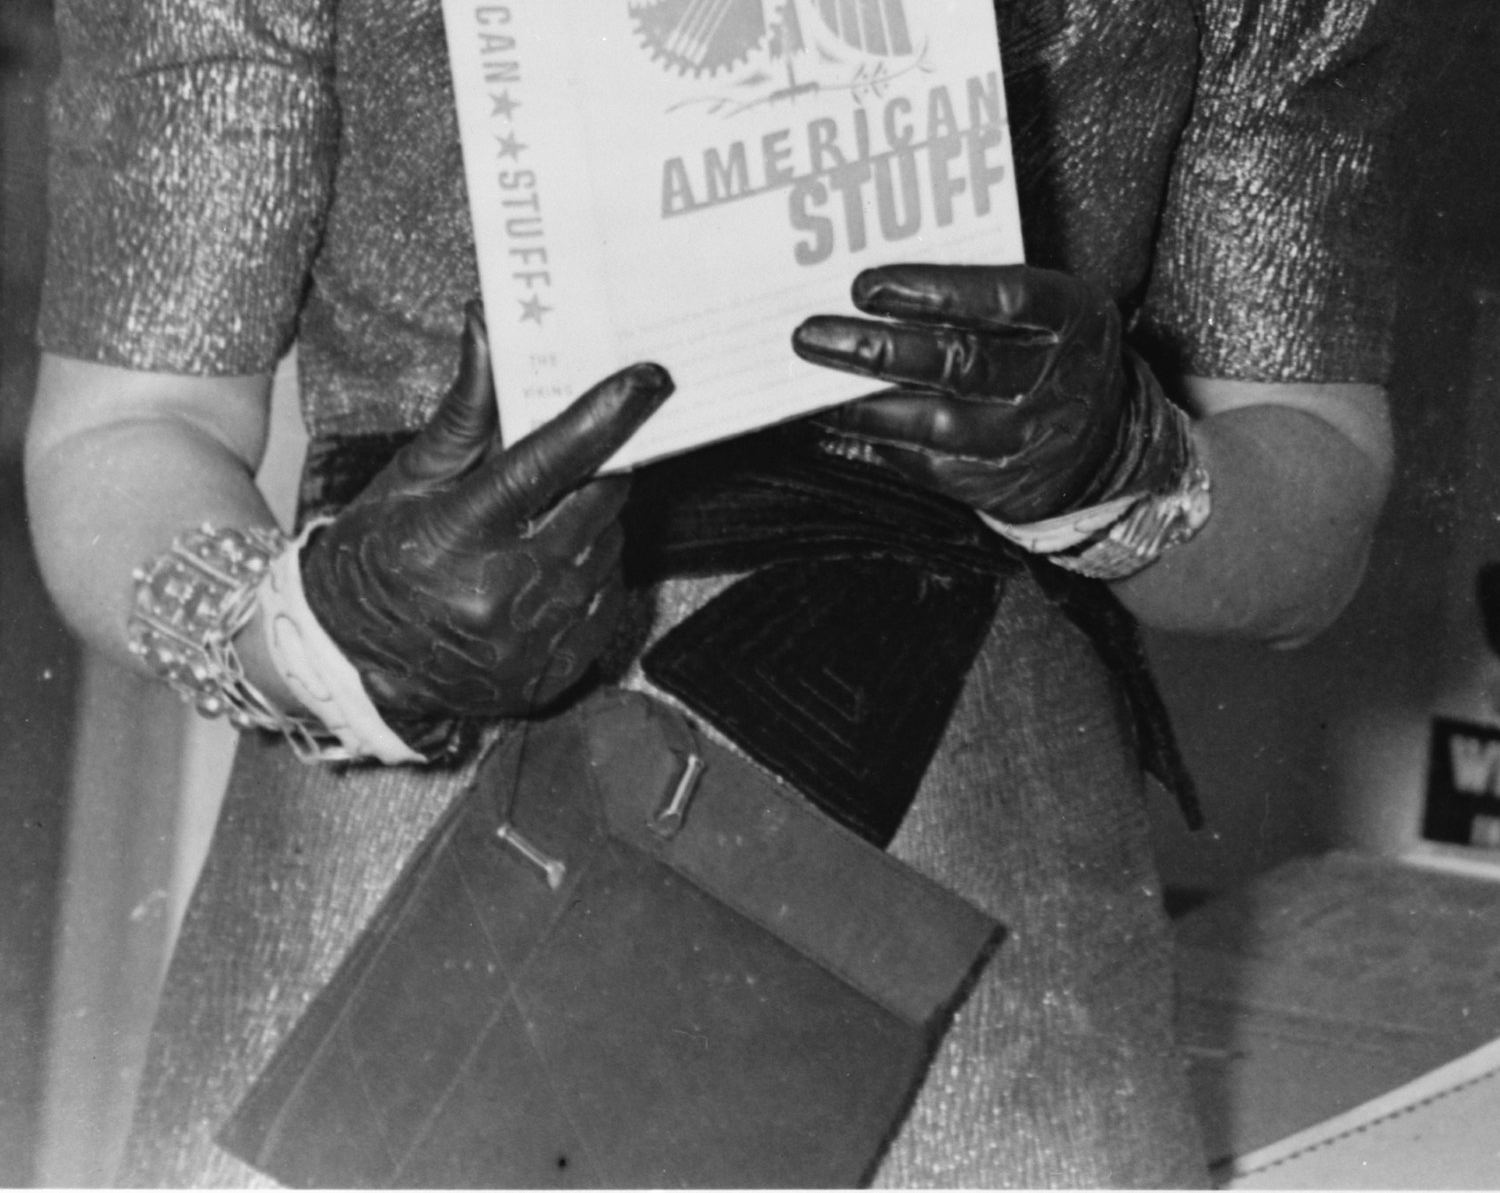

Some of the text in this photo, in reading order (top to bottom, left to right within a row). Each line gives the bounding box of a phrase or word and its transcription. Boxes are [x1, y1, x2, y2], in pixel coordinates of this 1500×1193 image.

[661, 71, 1001, 219] AMERICAN
[788, 127, 1005, 267] STUFF
[496, 169, 552, 289] STUFF
